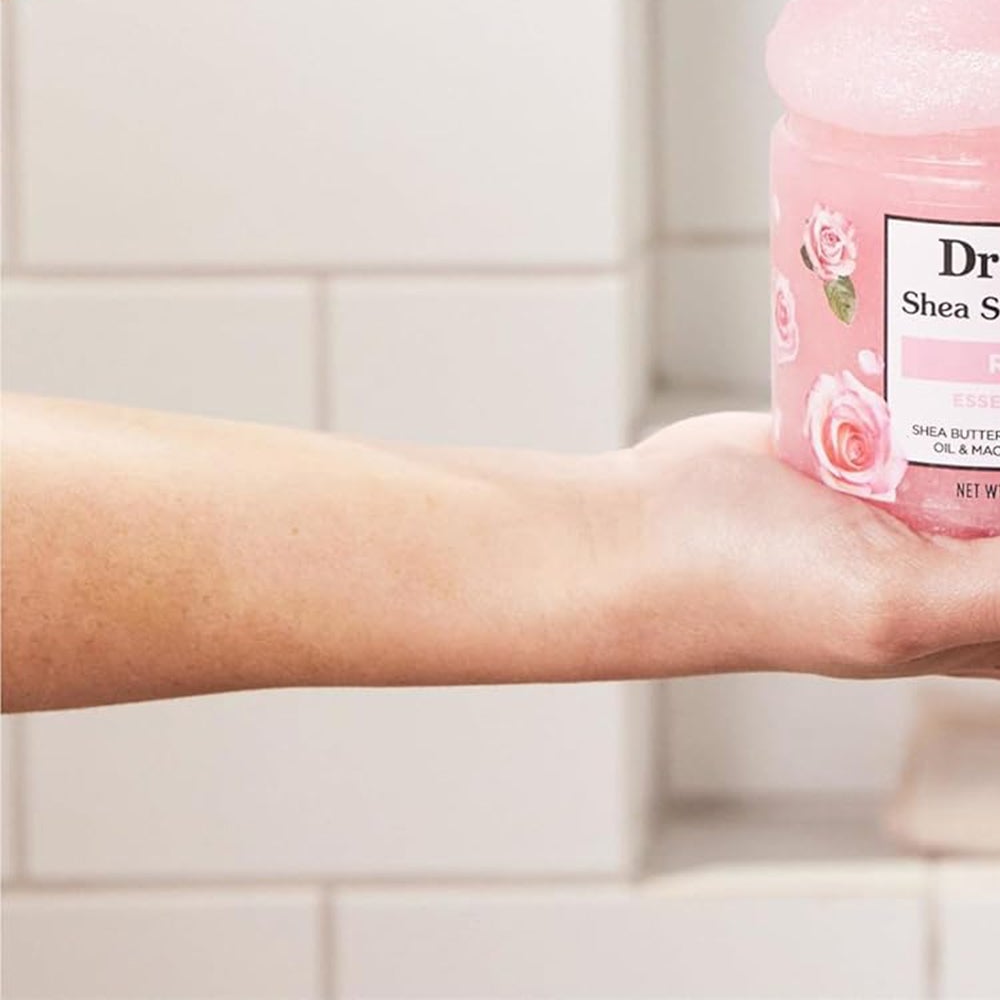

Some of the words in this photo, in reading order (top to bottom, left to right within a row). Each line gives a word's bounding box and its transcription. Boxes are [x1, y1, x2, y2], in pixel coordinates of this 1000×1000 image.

[938, 239, 998, 278] Dr
[902, 291, 969, 319] Shea
[912, 424, 947, 438] SHEA
[933, 443, 956, 454] OIL
[959, 443, 968, 455] &
[957, 483, 979, 499] NET
